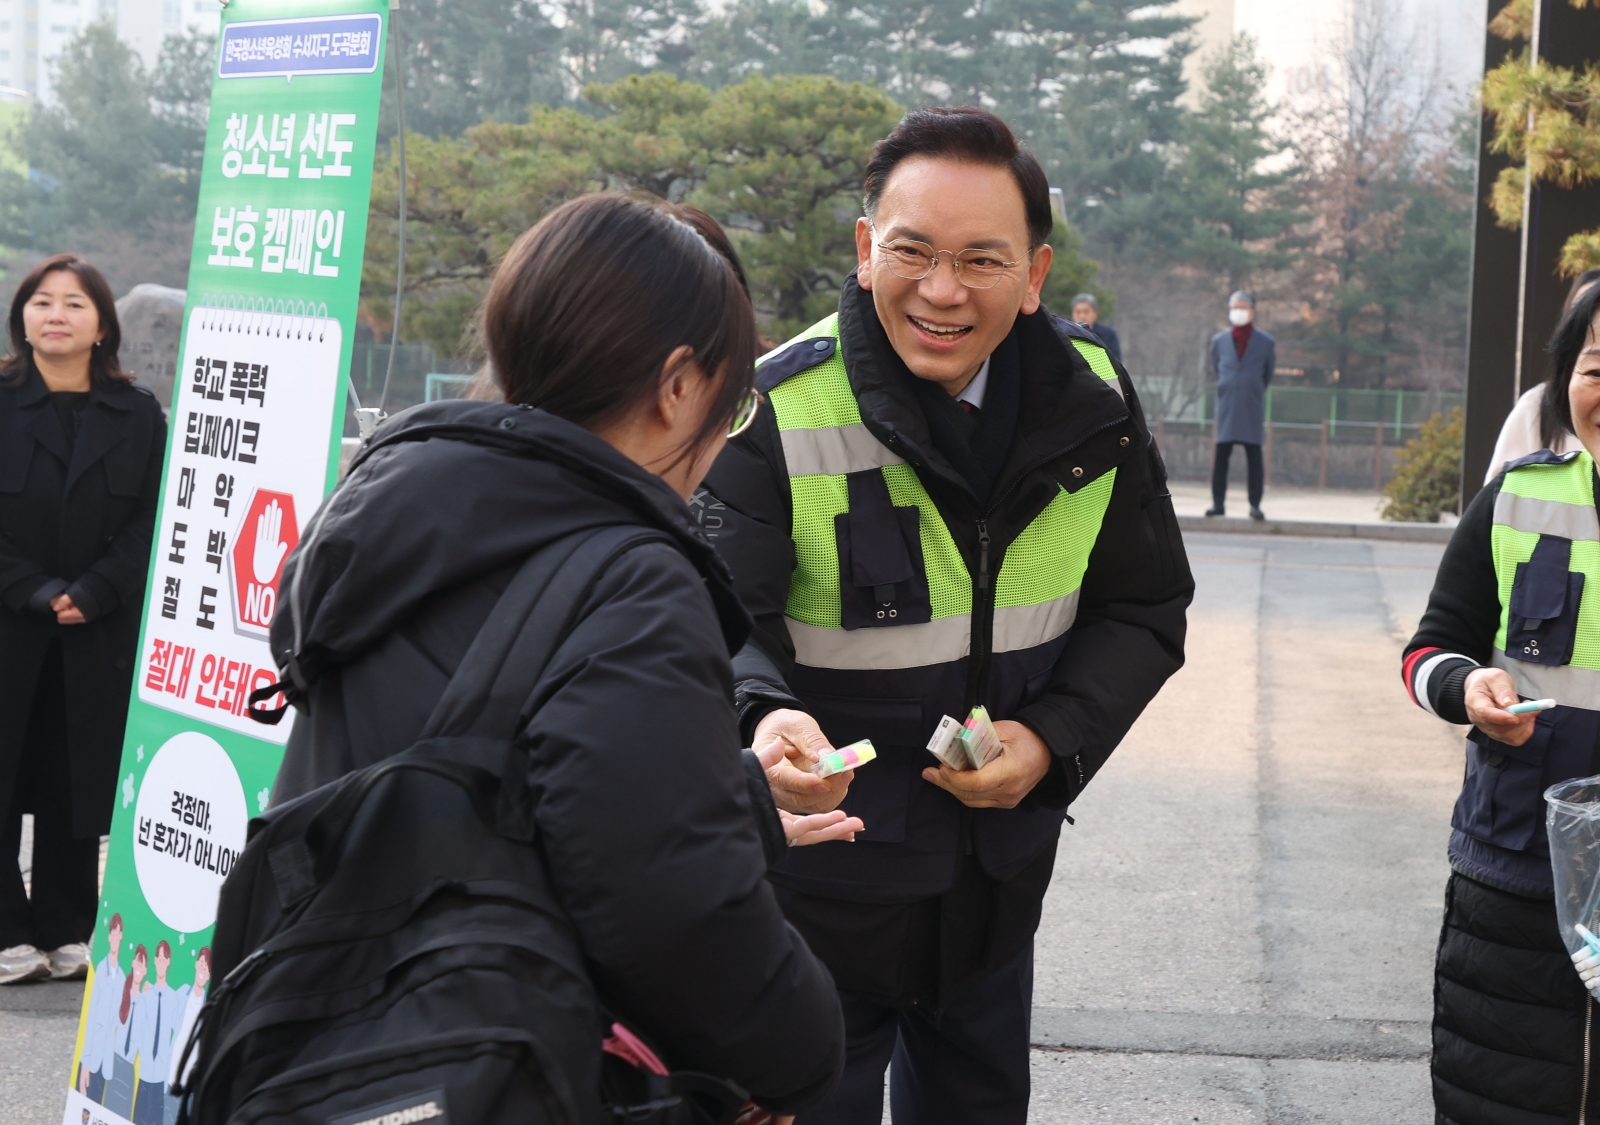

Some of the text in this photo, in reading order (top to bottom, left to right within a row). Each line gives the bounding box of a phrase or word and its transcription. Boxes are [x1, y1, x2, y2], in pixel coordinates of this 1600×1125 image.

[224, 30, 372, 62] 한국청소년육성회 수서지구 도곡분회
[221, 113, 356, 179] 청소년 선도
[207, 205, 345, 278] 보호 캠페인
[184, 411, 260, 465] 딥페이크
[244, 582, 276, 626] NO
[145, 638, 196, 699] 절대
[171, 790, 212, 835] 걱정마,
[138, 815, 152, 847] 넌
[153, 822, 192, 863] 혼자가
